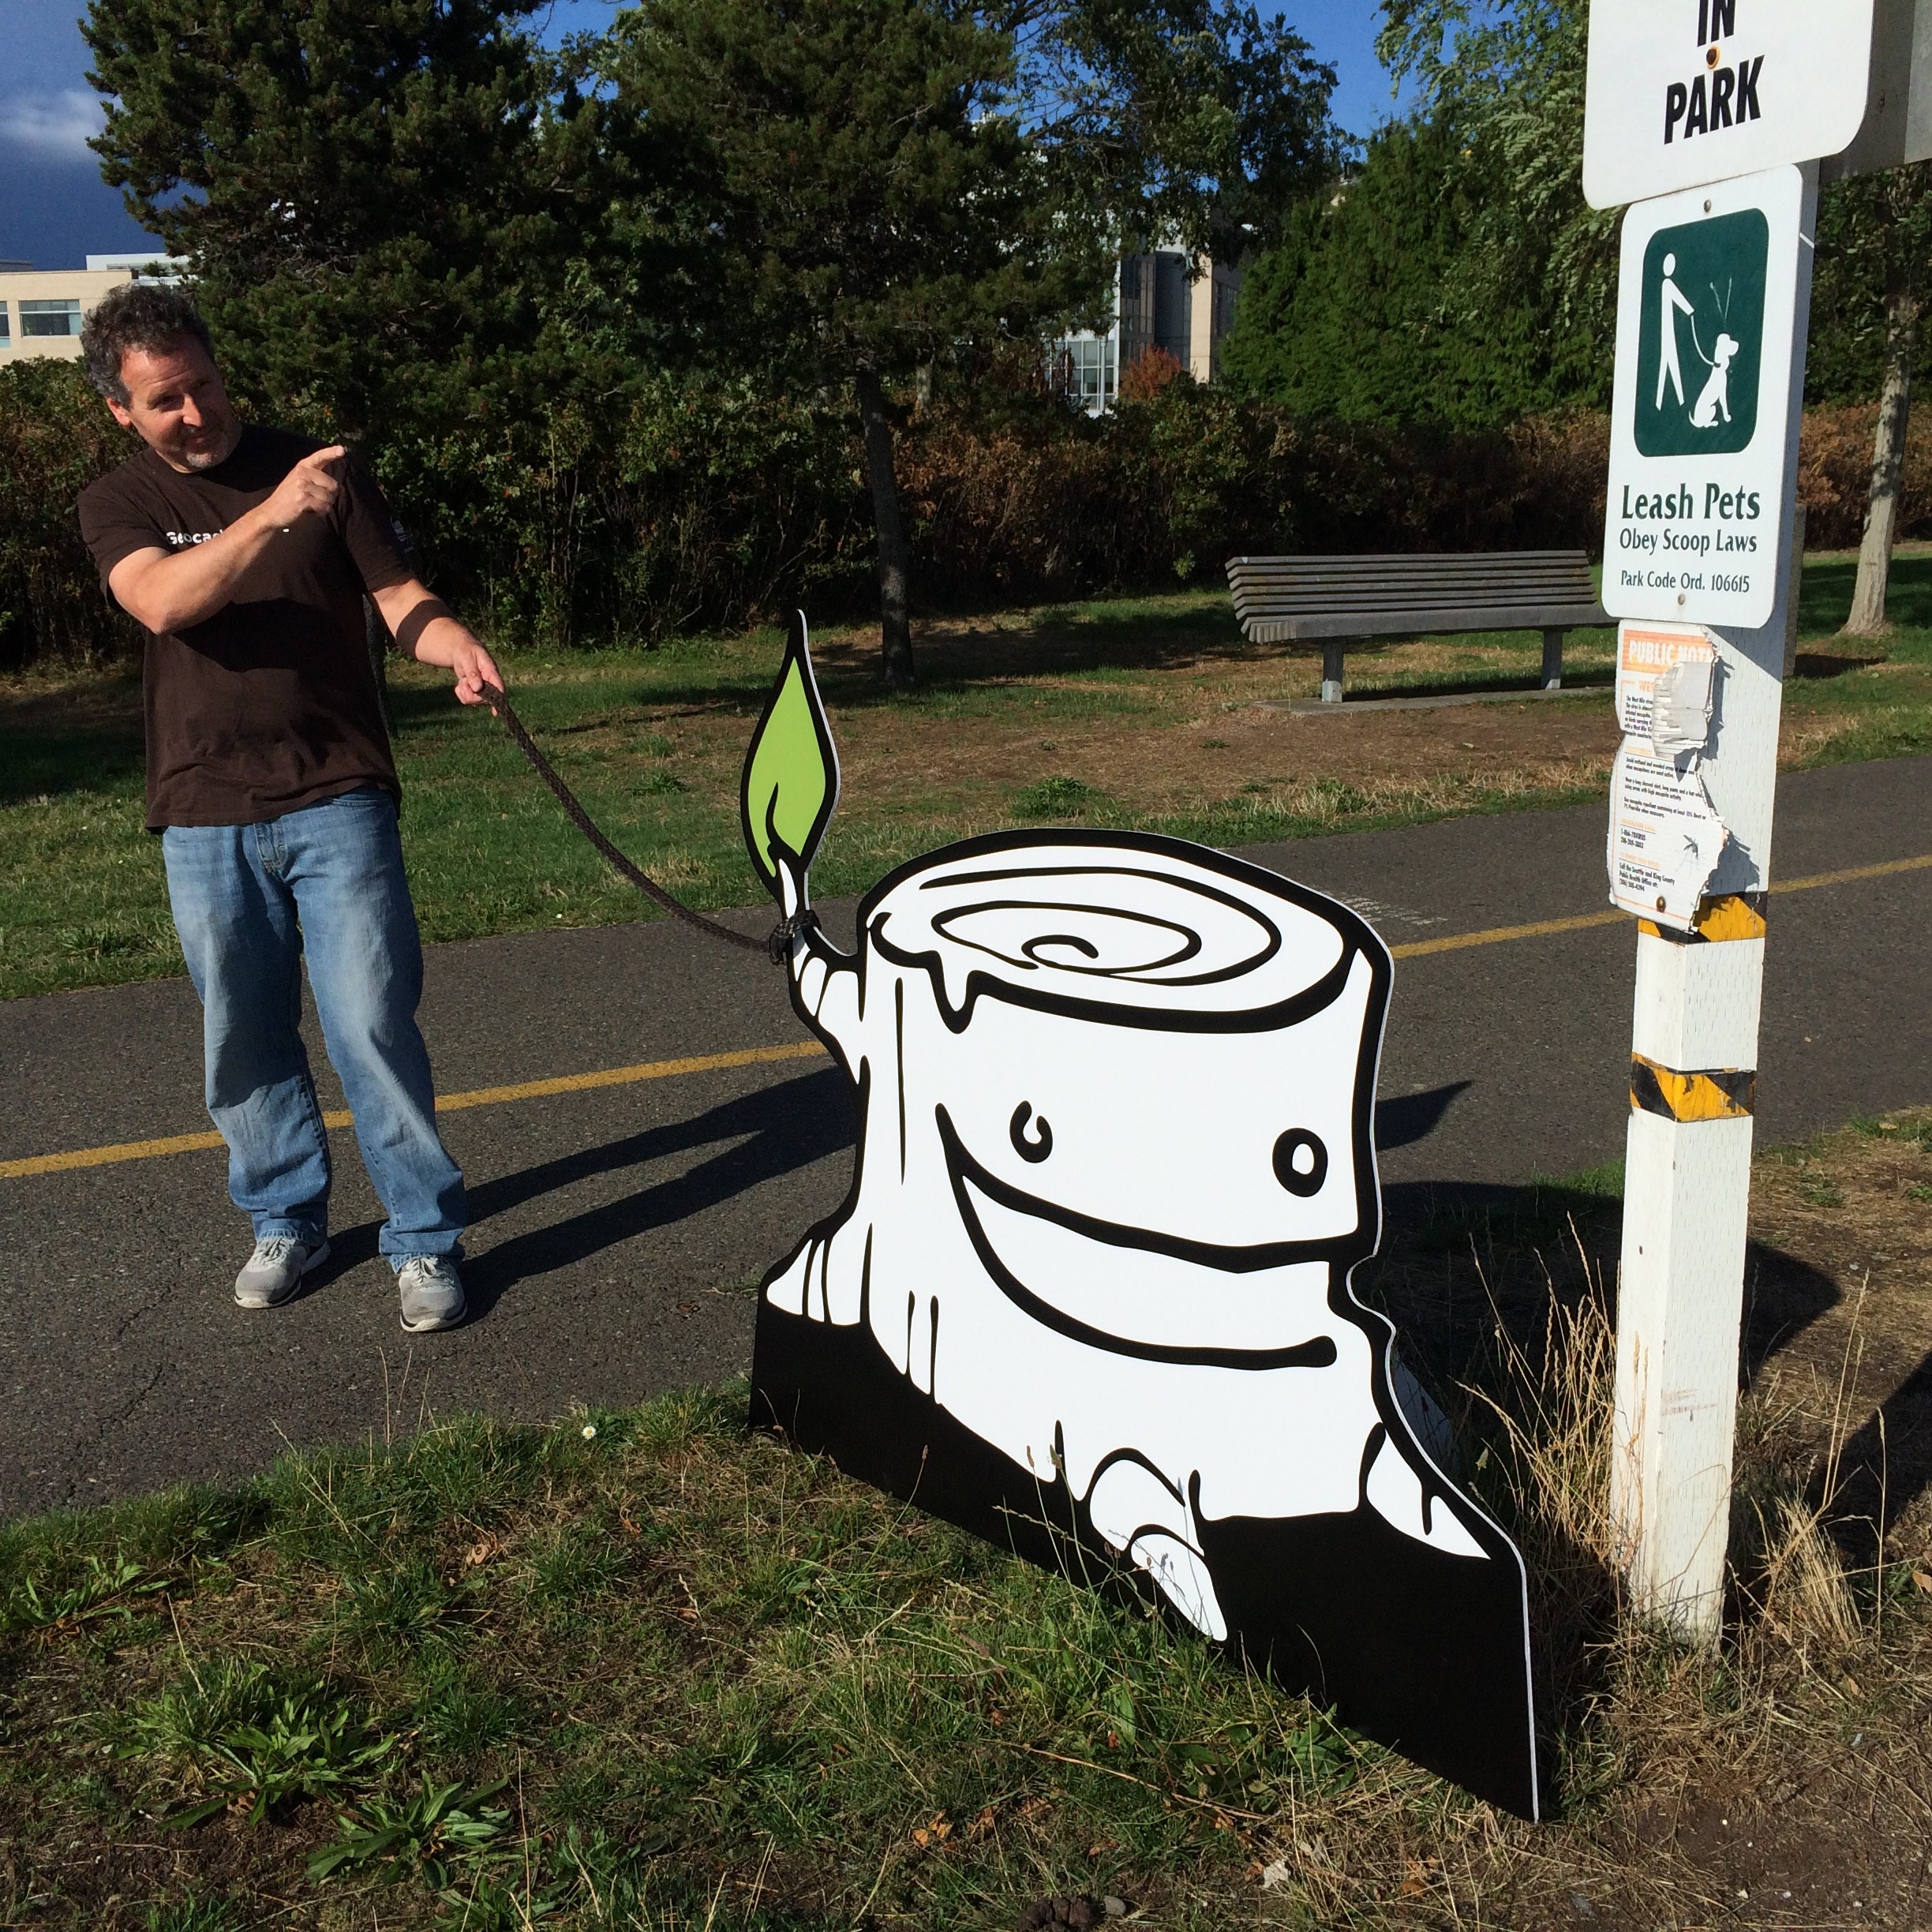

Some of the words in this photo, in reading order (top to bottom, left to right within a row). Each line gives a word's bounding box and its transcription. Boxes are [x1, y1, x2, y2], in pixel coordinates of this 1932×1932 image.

[1698, 0, 1735, 47] IN
[1664, 54, 1765, 144] PARK
[1622, 483, 1693, 519] Leash
[1704, 483, 1761, 519] Pets
[1620, 528, 1658, 556] Obey
[1663, 529, 1710, 556] Scoop
[1716, 530, 1757, 552] Laws
[1621, 570, 1643, 586] Park
[1647, 571, 1676, 588] Code
[1681, 572, 1705, 590] Ord.
[1711, 574, 1750, 593] 106615
[1629, 640, 1674, 666] PUBLIC
